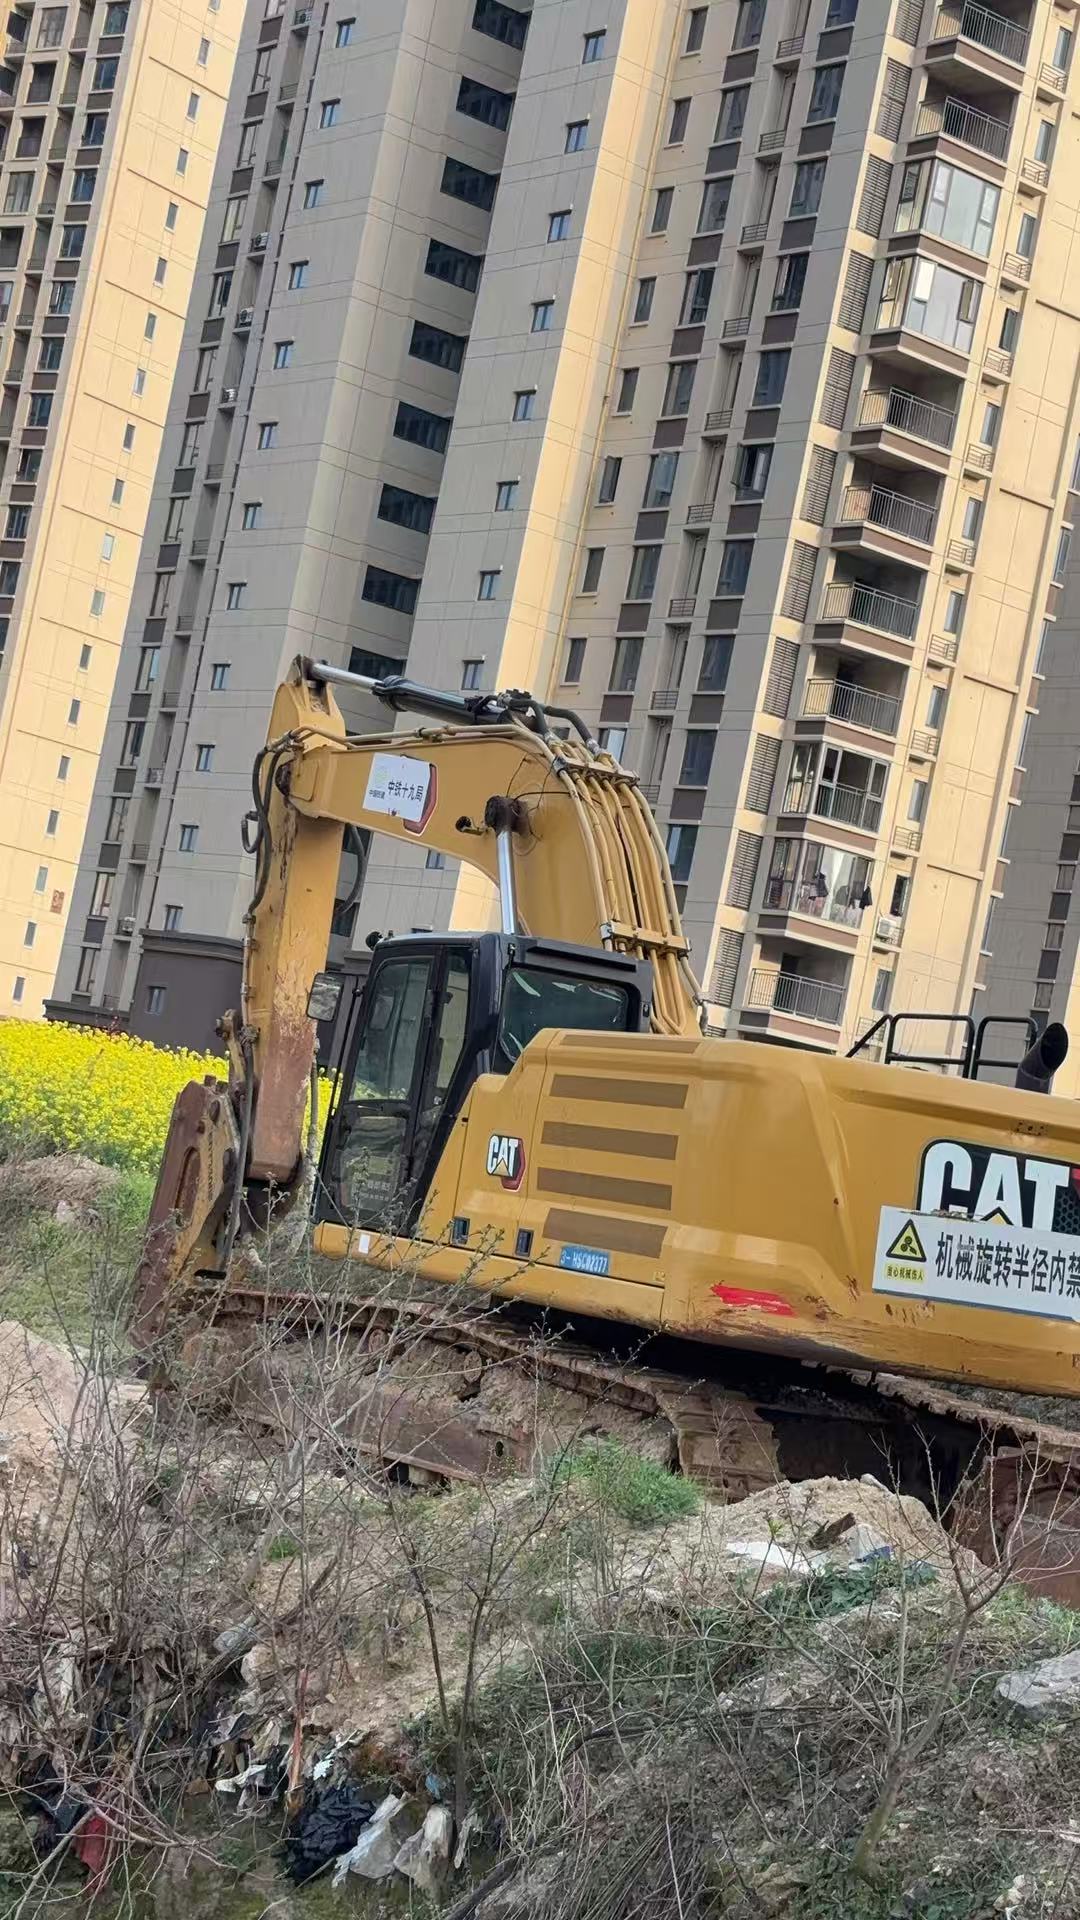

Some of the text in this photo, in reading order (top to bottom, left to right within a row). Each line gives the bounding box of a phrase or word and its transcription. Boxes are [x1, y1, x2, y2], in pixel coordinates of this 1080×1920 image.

[388, 780, 424, 801] 中铁十九局
[487, 1135, 519, 1177] CAT
[919, 1142, 1071, 1232] CAT
[887, 1265, 923, 1280] 当心机械伤人
[935, 1231, 1080, 1298] 机械旋转半径内禁
